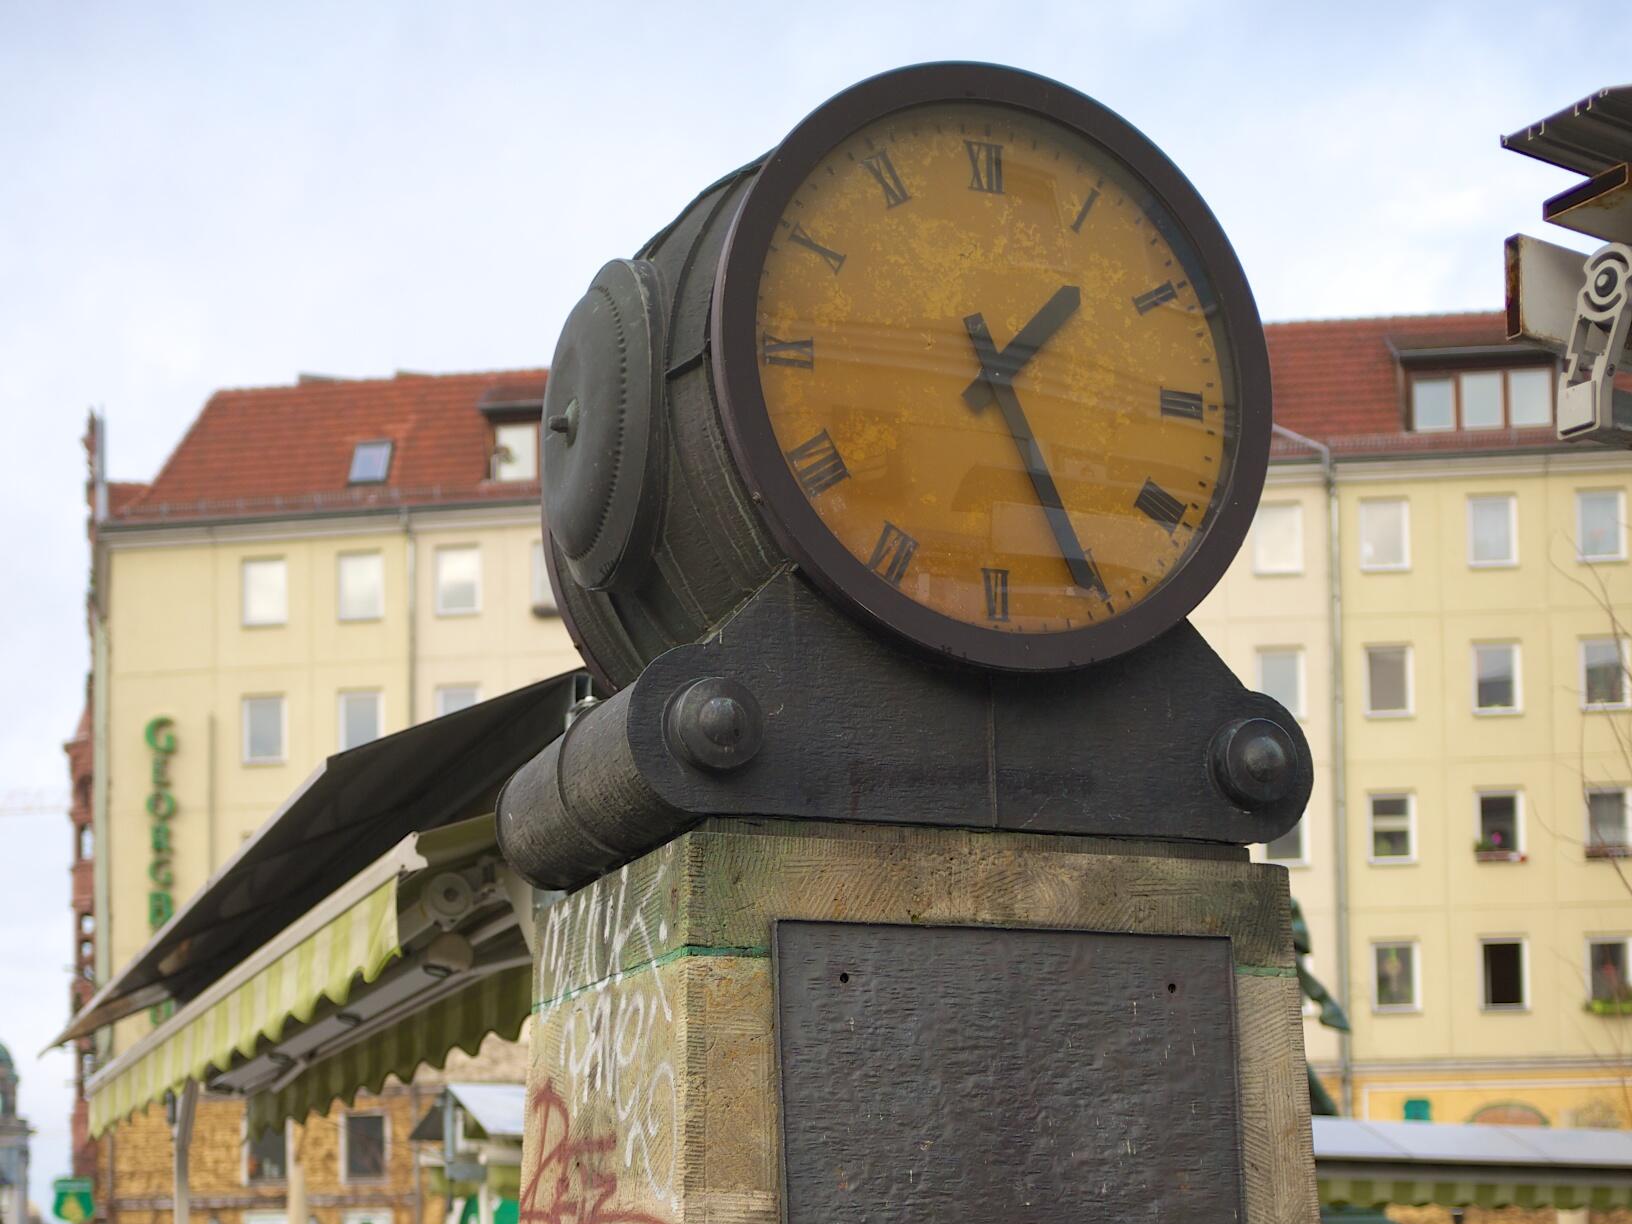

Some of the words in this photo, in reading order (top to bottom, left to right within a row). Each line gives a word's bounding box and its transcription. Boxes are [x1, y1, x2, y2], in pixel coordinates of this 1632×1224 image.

[861, 148, 912, 210] XI
[963, 139, 1005, 194] XII
[1070, 187, 1100, 234] I
[788, 224, 847, 275] X
[1131, 280, 1178, 316] II
[763, 331, 814, 369] IX
[1160, 386, 1203, 423] III
[785, 428, 852, 498] VIII
[867, 519, 919, 585] VII
[981, 567, 1010, 622] VI
